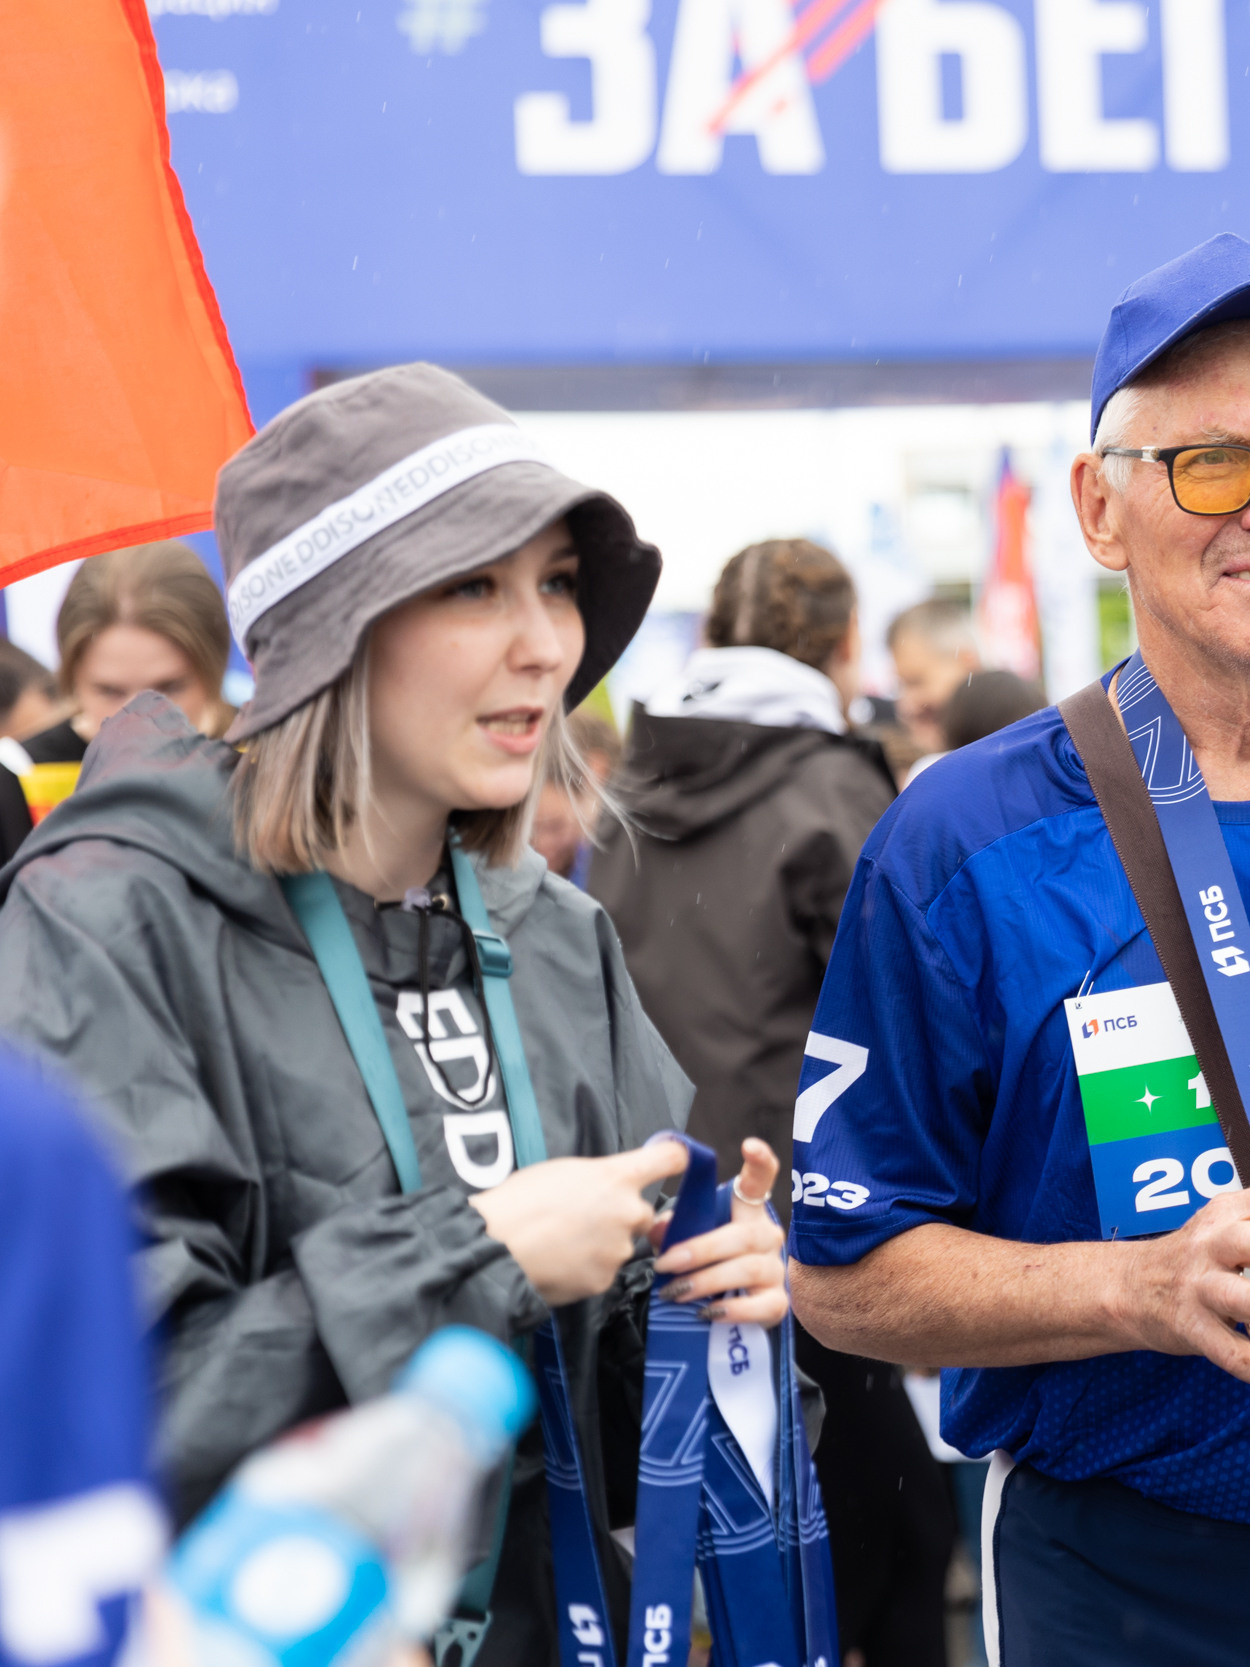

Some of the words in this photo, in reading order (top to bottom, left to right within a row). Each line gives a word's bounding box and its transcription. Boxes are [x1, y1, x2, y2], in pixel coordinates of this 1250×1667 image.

[1199, 885, 1236, 943] ПСБ
[1103, 1015, 1138, 1032] ПСБ
[792, 1030, 869, 1143] 7
[791, 1168, 870, 1210] 023
